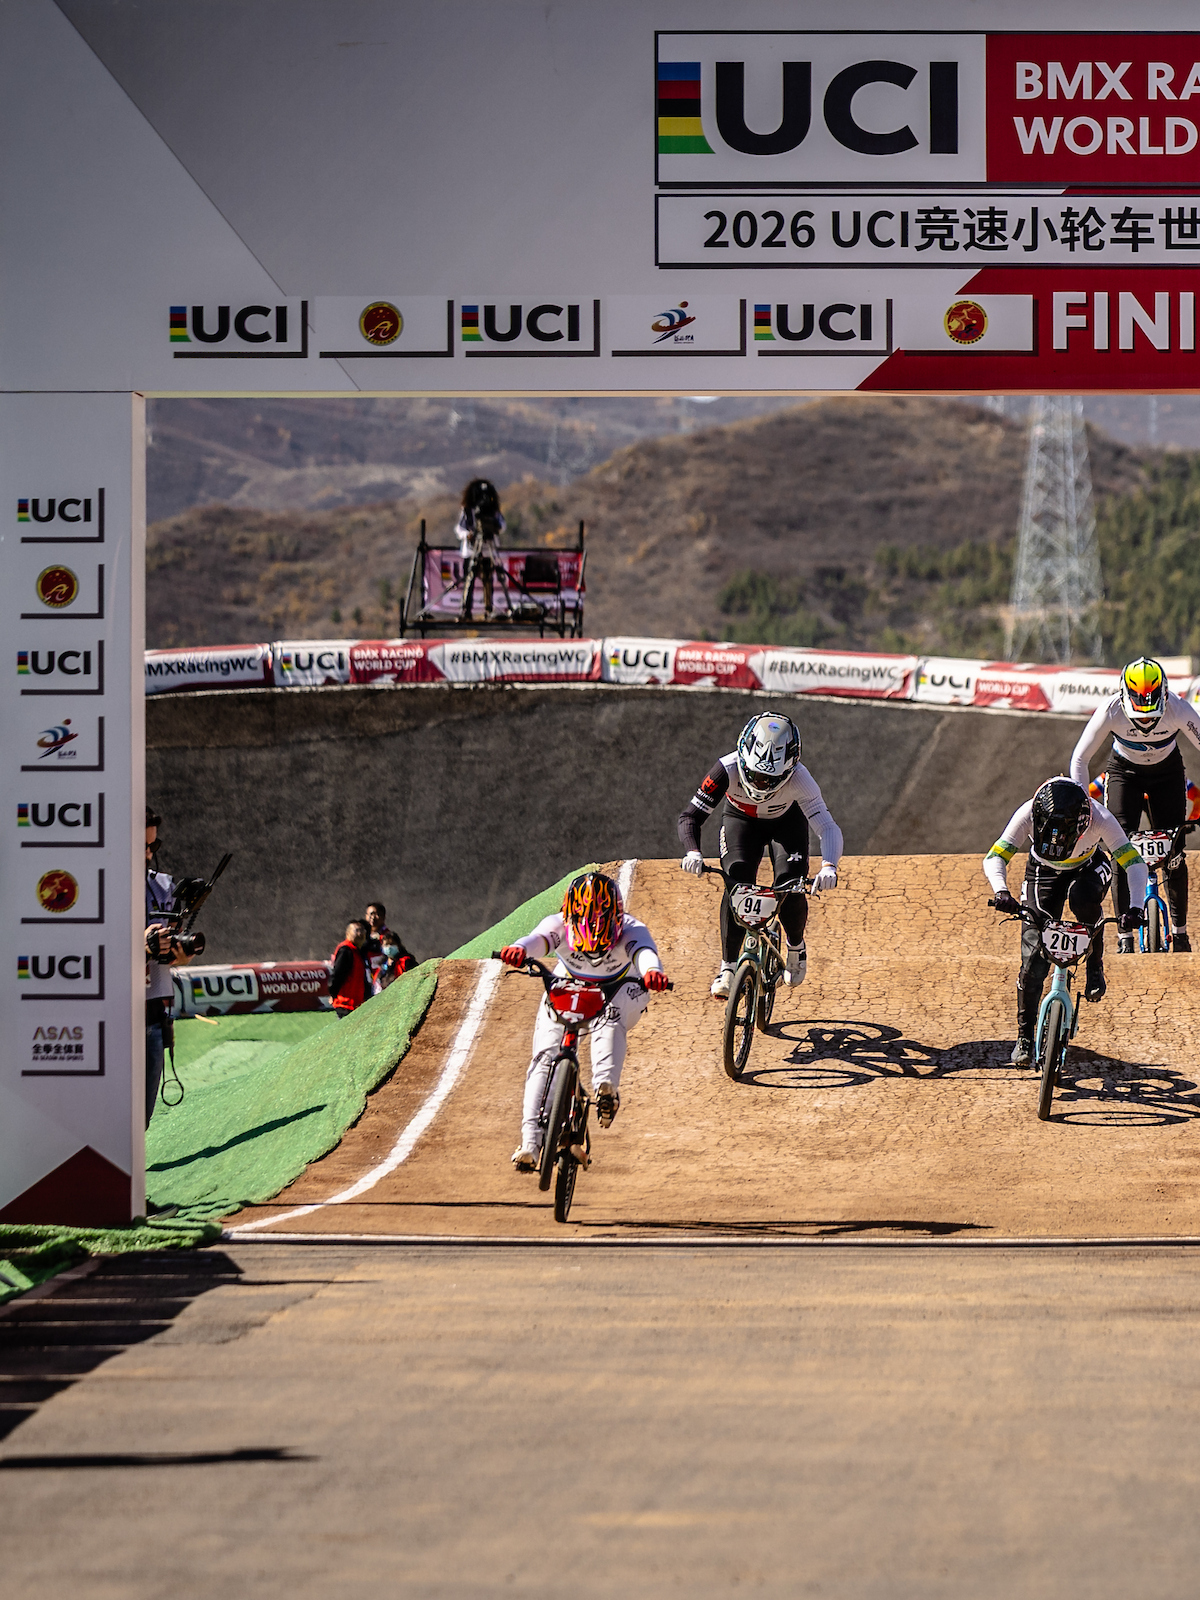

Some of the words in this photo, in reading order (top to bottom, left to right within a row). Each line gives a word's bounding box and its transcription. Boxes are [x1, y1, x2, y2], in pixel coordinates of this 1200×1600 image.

[1016, 62, 1133, 100] BMX
[715, 60, 958, 155] UCI
[1013, 116, 1198, 155] WORLD
[704, 211, 815, 248] 2026
[192, 305, 288, 343] UCI
[484, 305, 580, 342] UCI
[776, 303, 872, 341] UCI
[31, 498, 92, 522] UCI
[31, 650, 92, 675] UCI
[145, 657, 258, 676] MXRacingWC
[295, 652, 345, 671] UCI
[354, 649, 379, 660] BMX
[382, 648, 424, 660] RACING
[354, 660, 392, 671] WORLD
[395, 659, 417, 671] CUP
[450, 649, 587, 667] #BMXRacingWC
[622, 649, 669, 668] UCI
[677, 662, 714, 674] WORLD
[716, 663, 737, 675] CUP
[769, 660, 899, 681] #BMXRacingWC
[31, 802, 92, 828] UCI
[1139, 841, 1165, 856] 150
[743, 897, 762, 915] 94
[1050, 932, 1078, 951] 201
[31, 955, 92, 979] UCI
[203, 974, 253, 997] UCI
[260, 971, 285, 982] BMX
[286, 969, 327, 981] RACING
[262, 982, 299, 994] WORLD
[300, 981, 321, 993] CUP
[569, 992, 580, 1011] 1
